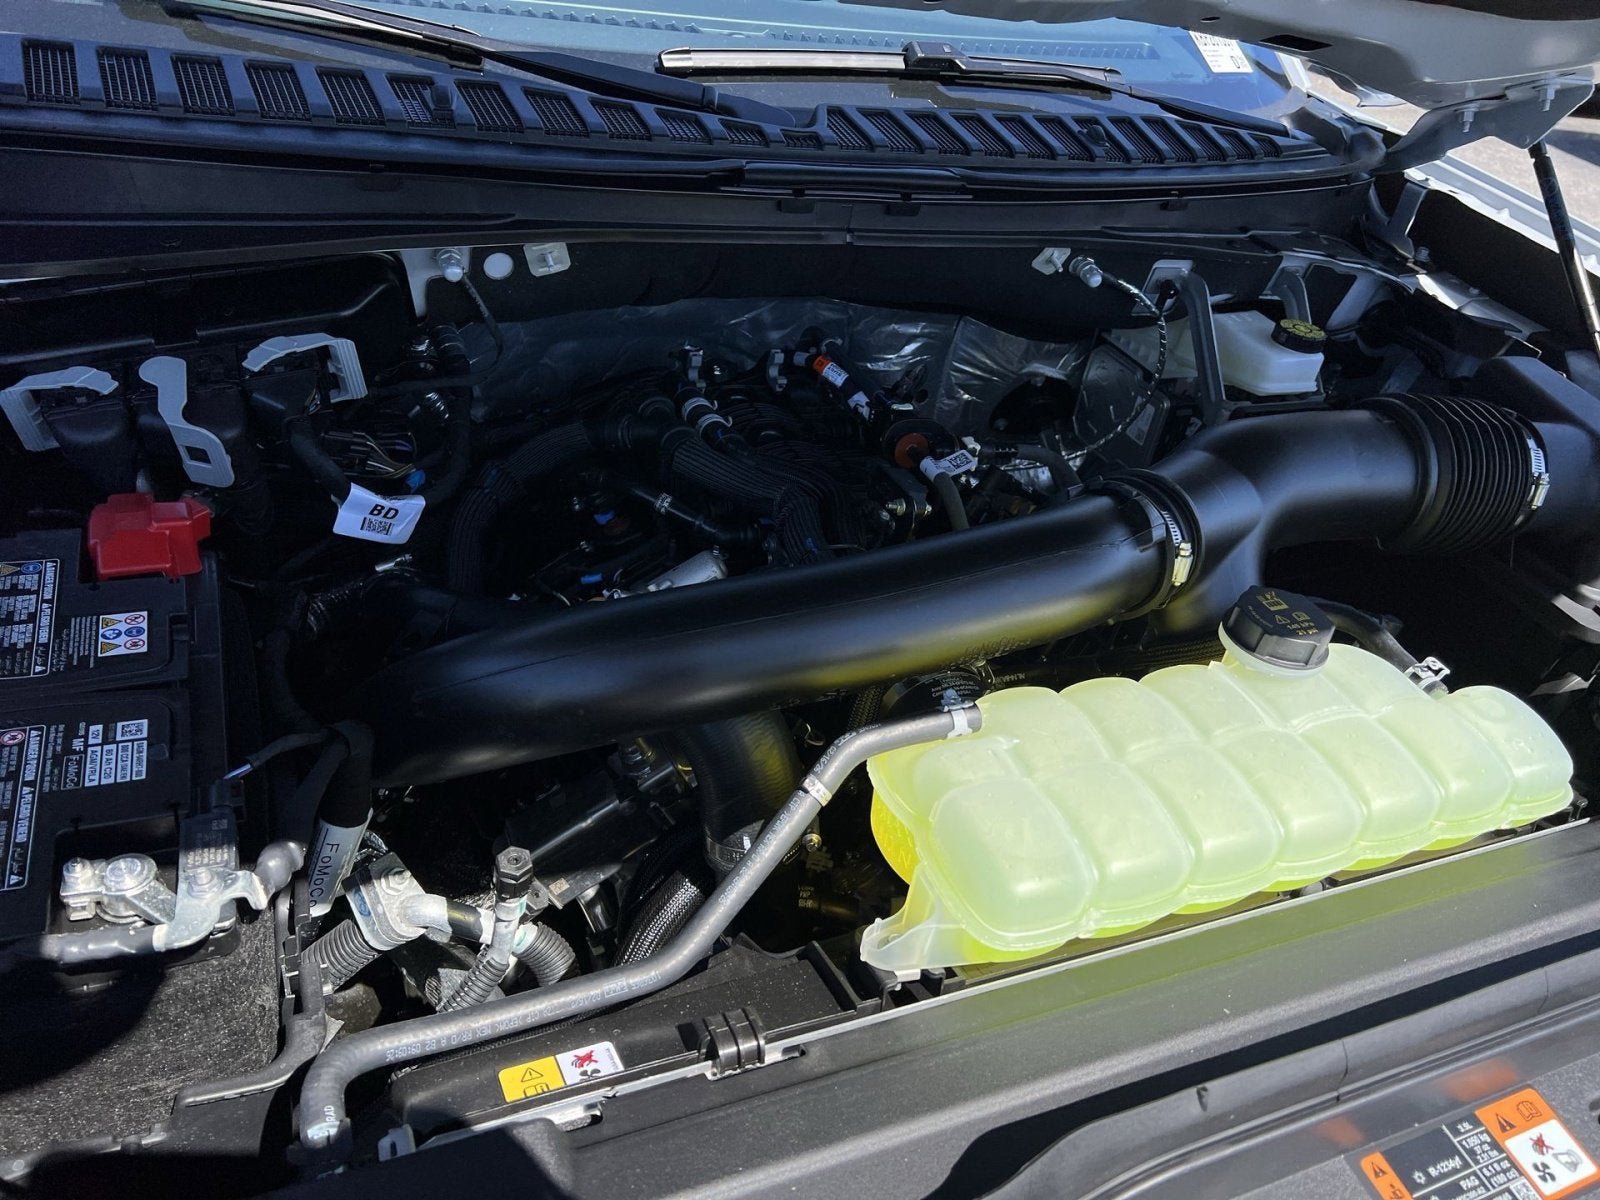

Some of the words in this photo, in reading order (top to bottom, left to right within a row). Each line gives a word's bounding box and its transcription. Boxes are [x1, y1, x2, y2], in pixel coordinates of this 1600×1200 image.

[368, 504, 399, 520] BD
[92, 729, 100, 740] 12V
[72, 738, 84, 751] MF
[66, 756, 80, 788] FoMoCo
[88, 750, 98, 782] AGM/VRLA
[104, 768, 112, 780] C20
[309, 842, 340, 908] FoMoCo
[326, 1106, 334, 1124] RAD
[1460, 1176, 1480, 1190] PAG
